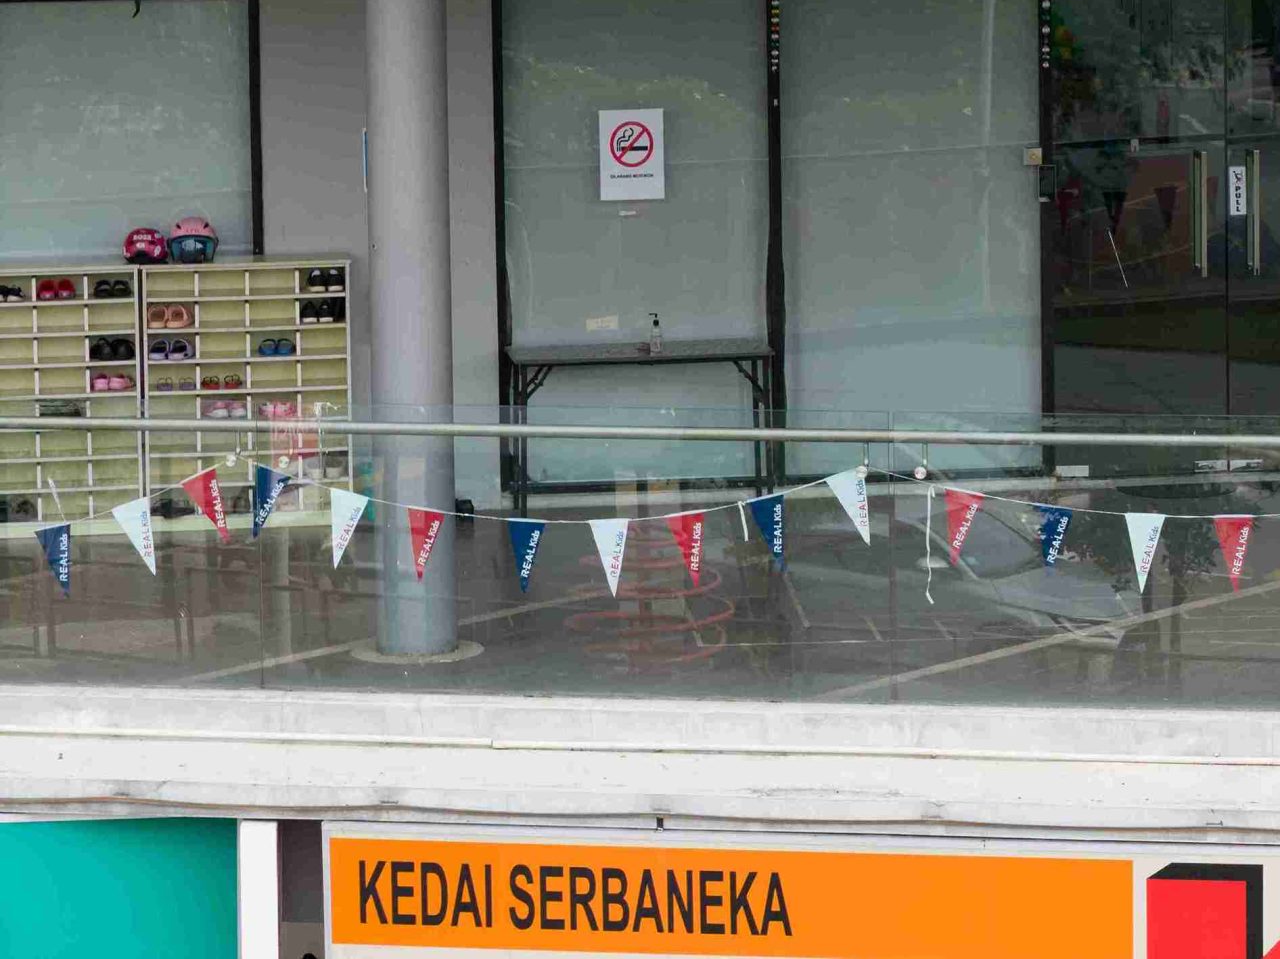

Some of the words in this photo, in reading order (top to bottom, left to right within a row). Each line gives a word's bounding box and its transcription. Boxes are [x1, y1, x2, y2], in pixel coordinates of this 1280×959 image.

[210, 479, 220, 497] Kids
[271, 481, 285, 498] Kids
[964, 503, 978, 521] Kids
[428, 520, 441, 537] Kids
[693, 523, 701, 539] Kids
[1057, 516, 1069, 534] Kids
[529, 530, 540, 547] Kids
[1239, 526, 1250, 544] Kids
[358, 860, 492, 928] KEDAI
[509, 864, 792, 936] SERBANEKA
